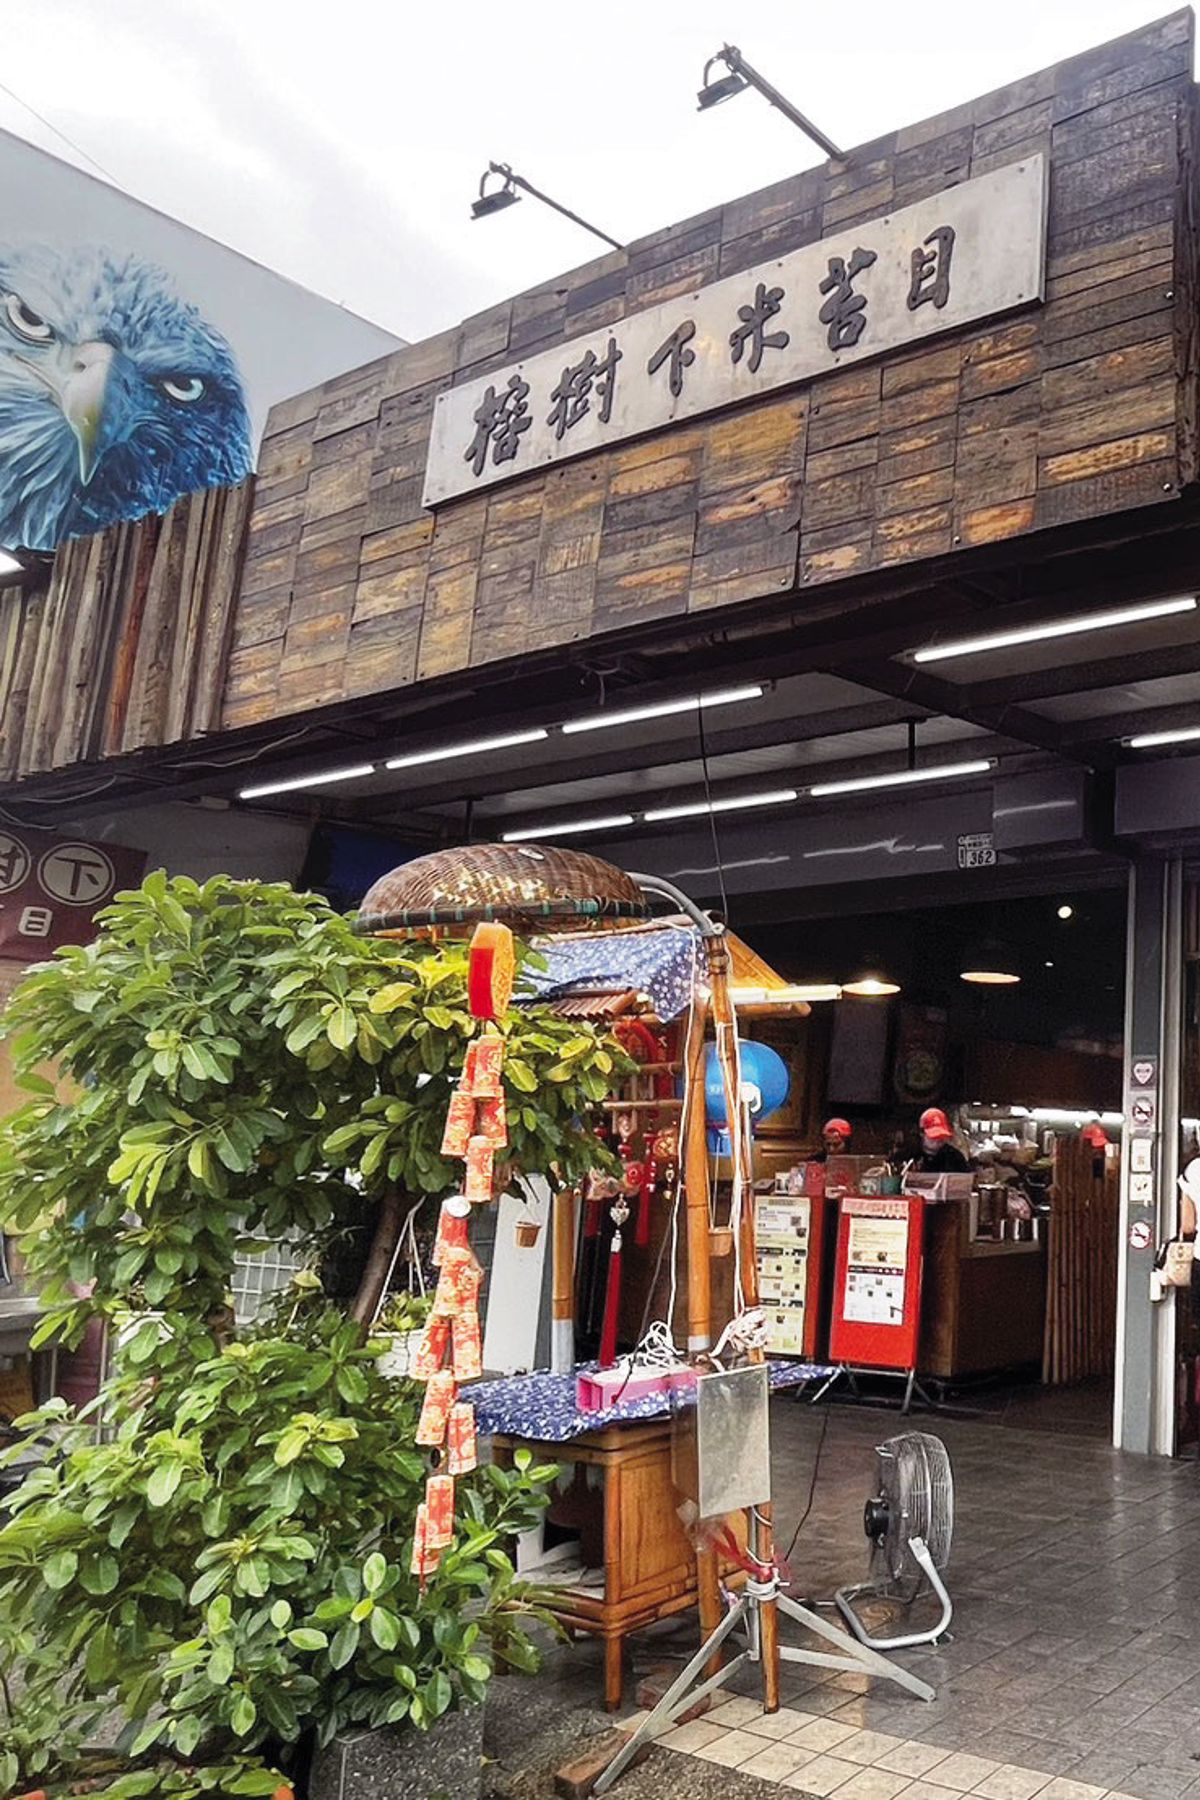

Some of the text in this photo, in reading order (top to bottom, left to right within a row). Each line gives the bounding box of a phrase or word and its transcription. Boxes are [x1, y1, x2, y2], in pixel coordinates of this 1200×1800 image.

[464, 225, 956, 476] 榕樹下米苔目
